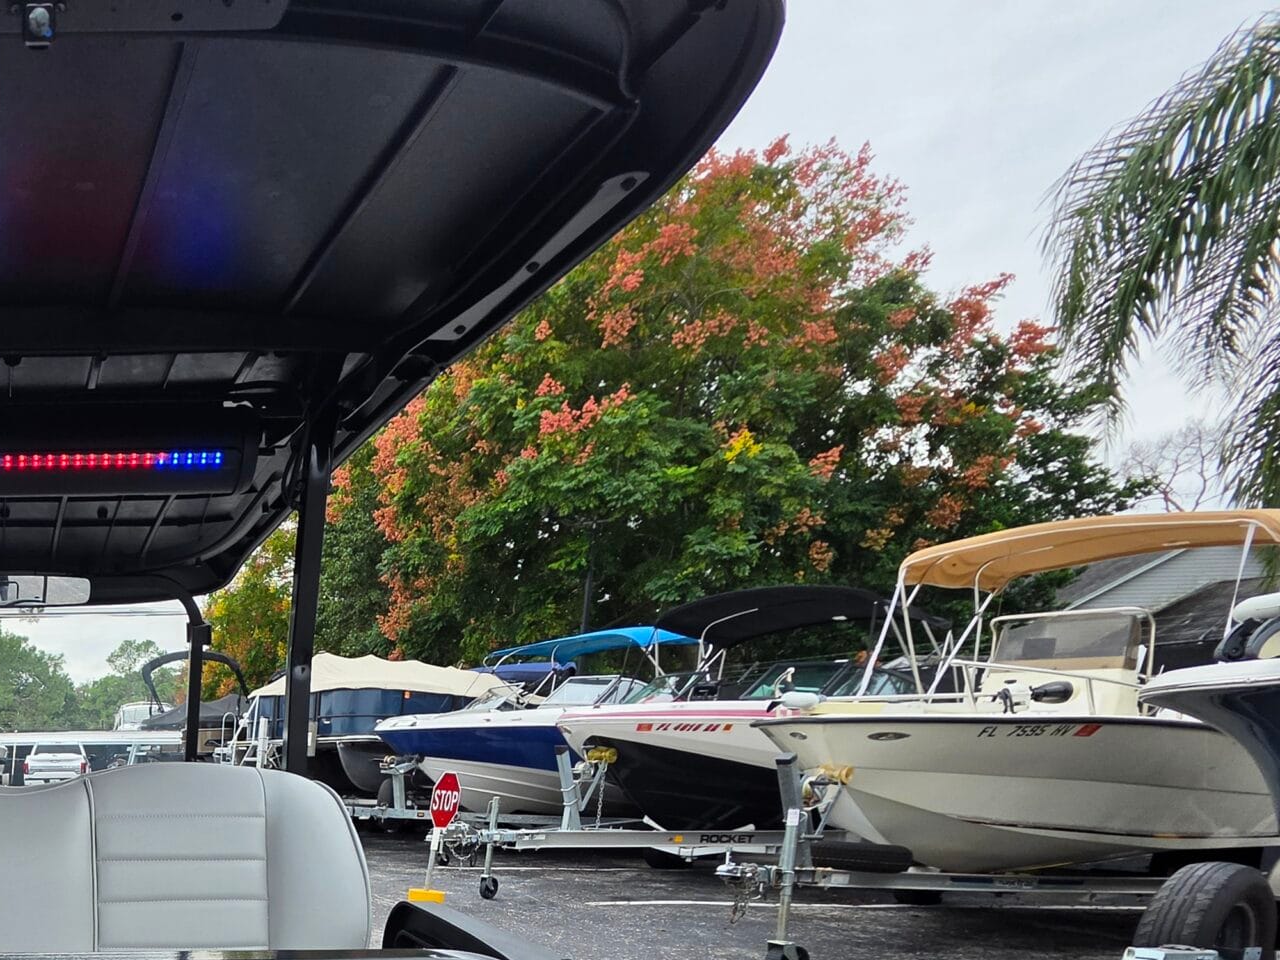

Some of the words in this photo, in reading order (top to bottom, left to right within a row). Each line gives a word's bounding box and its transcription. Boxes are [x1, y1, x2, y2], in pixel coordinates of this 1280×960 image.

[977, 725, 998, 737] FL
[432, 789, 458, 811] STOP
[700, 834, 754, 844] ROCKET
